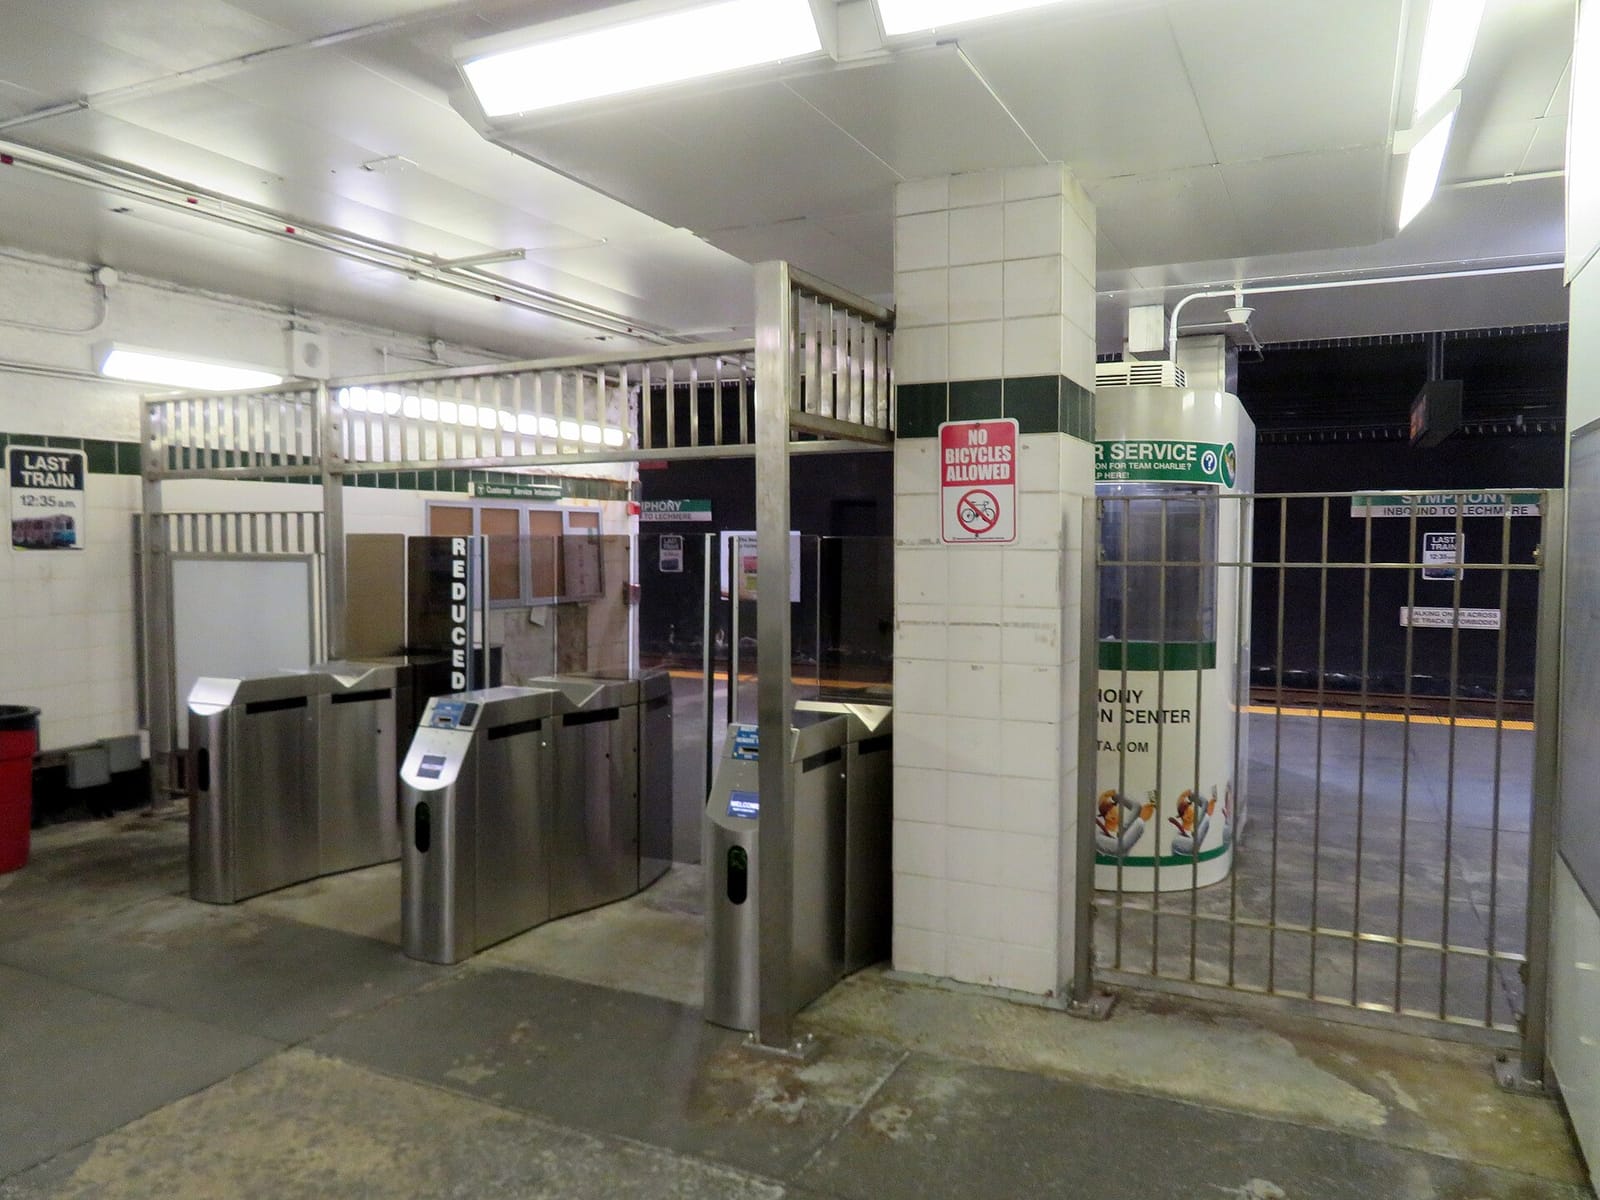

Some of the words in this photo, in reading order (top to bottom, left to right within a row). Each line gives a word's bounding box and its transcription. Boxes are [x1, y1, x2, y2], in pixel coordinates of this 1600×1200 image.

[968, 428, 988, 446] NO
[945, 445, 1012, 465] BICYCLES
[1110, 443, 1197, 461] SERVICE
[23, 454, 70, 472] LAST
[1109, 462, 1127, 470] FOR
[1129, 462, 1152, 470] TEAM
[1153, 462, 1192, 471] CHARLIE?
[21, 471, 76, 488] TRAIN
[946, 463, 1010, 482] ALLOWED
[21, 494, 56, 507] 12:35
[641, 500, 682, 511] PHONY
[1441, 506, 1457, 515] TO
[1461, 505, 1528, 515] LECHMRE
[1432, 536, 1455, 544] LAST
[451, 537, 466, 690] REDUCED
[1097, 688, 1143, 704] ONY
[1122, 708, 1191, 724] CENTER
